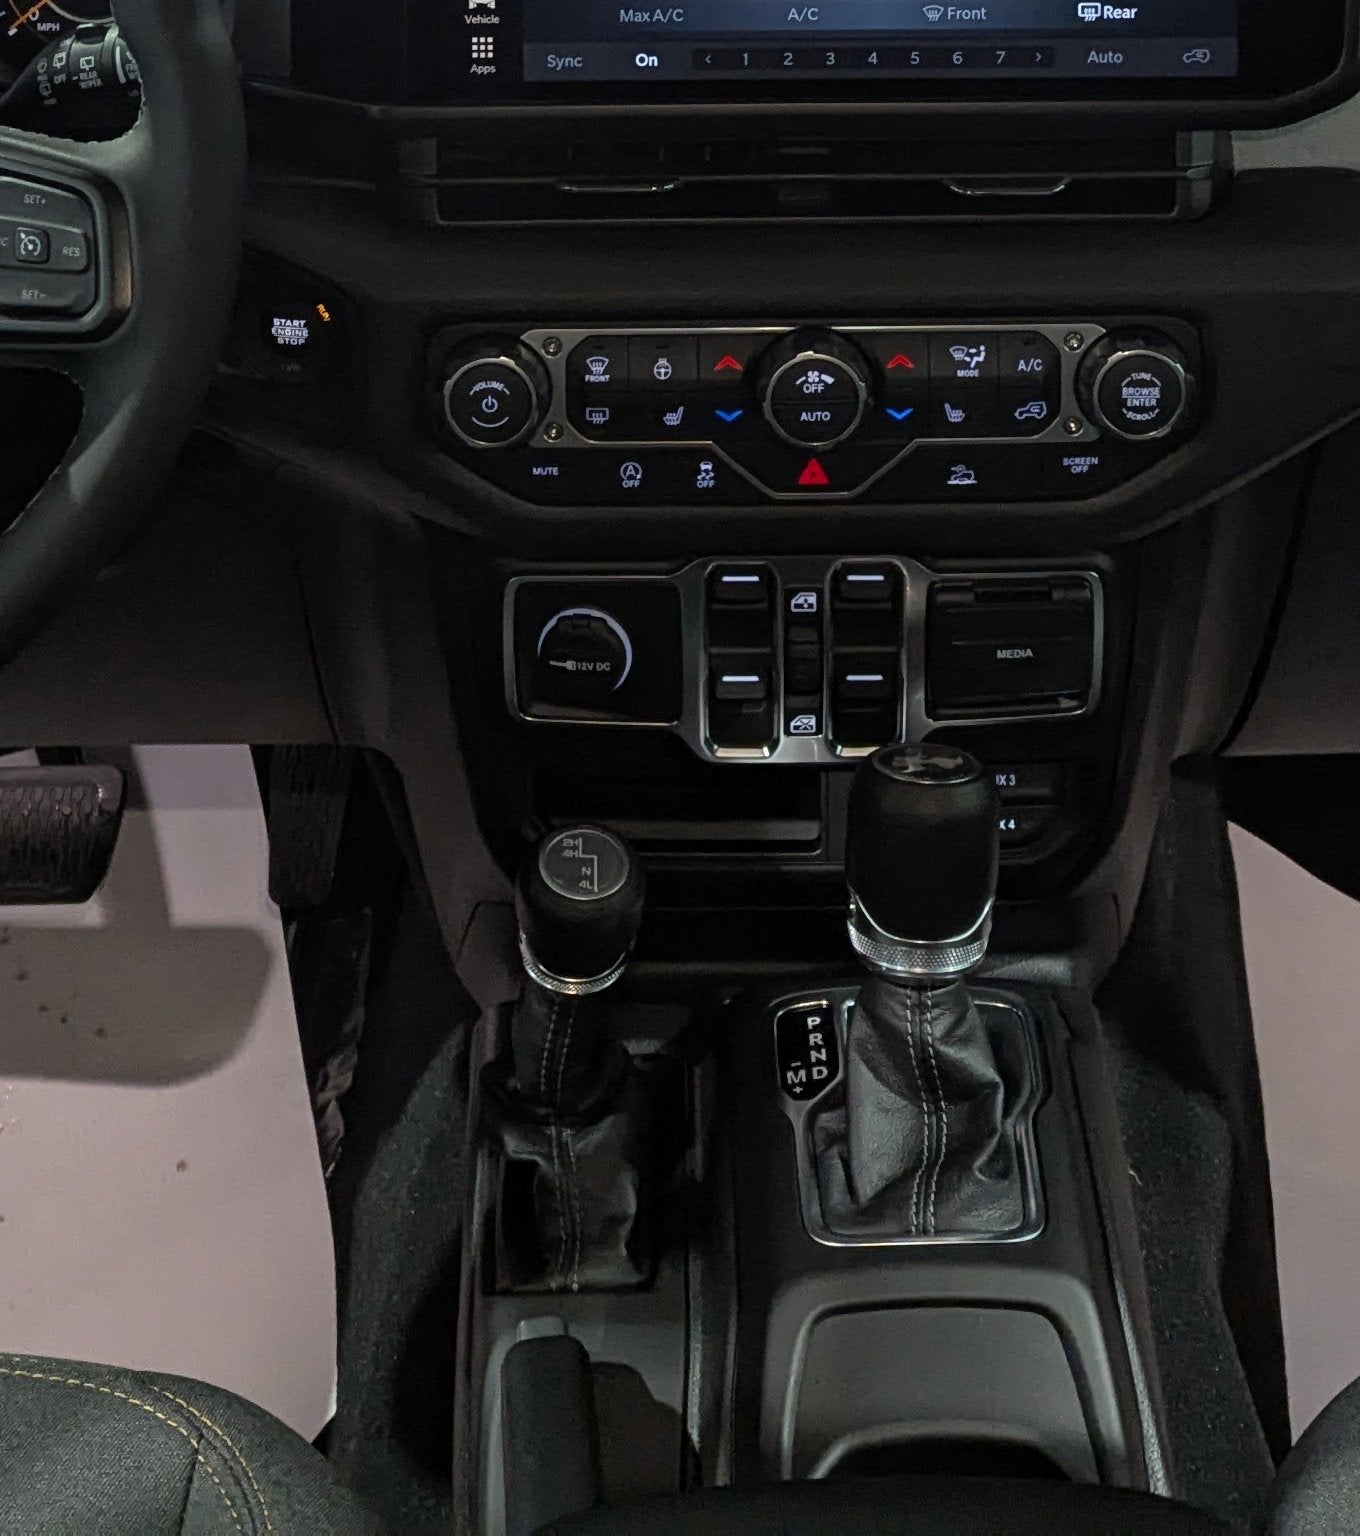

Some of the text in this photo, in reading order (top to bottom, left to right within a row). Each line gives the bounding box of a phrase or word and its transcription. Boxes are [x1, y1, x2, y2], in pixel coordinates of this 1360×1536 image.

[620, 8, 684, 23] Max A/C
[788, 8, 819, 22] A/C
[947, 6, 987, 20] Front
[1104, 6, 1138, 20] Rear
[464, 14, 500, 25] Vehicle
[37, 22, 60, 32] MPH
[547, 55, 583, 69] Sync
[635, 54, 658, 67] On
[743, 53, 749, 66] 1
[783, 53, 793, 66] 2
[825, 52, 835, 65] 3
[868, 52, 877, 65] 4
[910, 52, 920, 65] 5
[953, 51, 962, 64] 6
[996, 51, 1006, 64] 7
[1087, 50, 1123, 64] Auto
[470, 64, 496, 75] Apps
[62, 246, 81, 257] RES
[273, 318, 307, 327] START
[271, 327, 309, 337] ENGINE
[277, 337, 306, 345] STOP
[1018, 358, 1043, 372] A/C
[584, 374, 610, 382] FRONT
[957, 369, 979, 377] MODE
[1131, 372, 1152, 381] TUNE
[803, 383, 824, 394] OFF
[1122, 387, 1160, 397] BROWSE
[1127, 398, 1157, 407] ENTER
[800, 411, 831, 422] AUTO
[1125, 410, 1157, 421] SCROLL
[1063, 457, 1098, 465] SCREEN
[532, 467, 559, 476] MUTE
[1071, 465, 1089, 473] OFF
[622, 479, 640, 488] OFF
[696, 479, 715, 488] OFF
[996, 648, 1034, 659] MEDIA
[576, 661, 611, 671] 12V DC
[1009, 774, 1016, 785] 3
[807, 1016, 821, 1030] P
[809, 1033, 823, 1046] R
[810, 1049, 826, 1062] N
[787, 1070, 806, 1084] M
[812, 1066, 828, 1080] D
